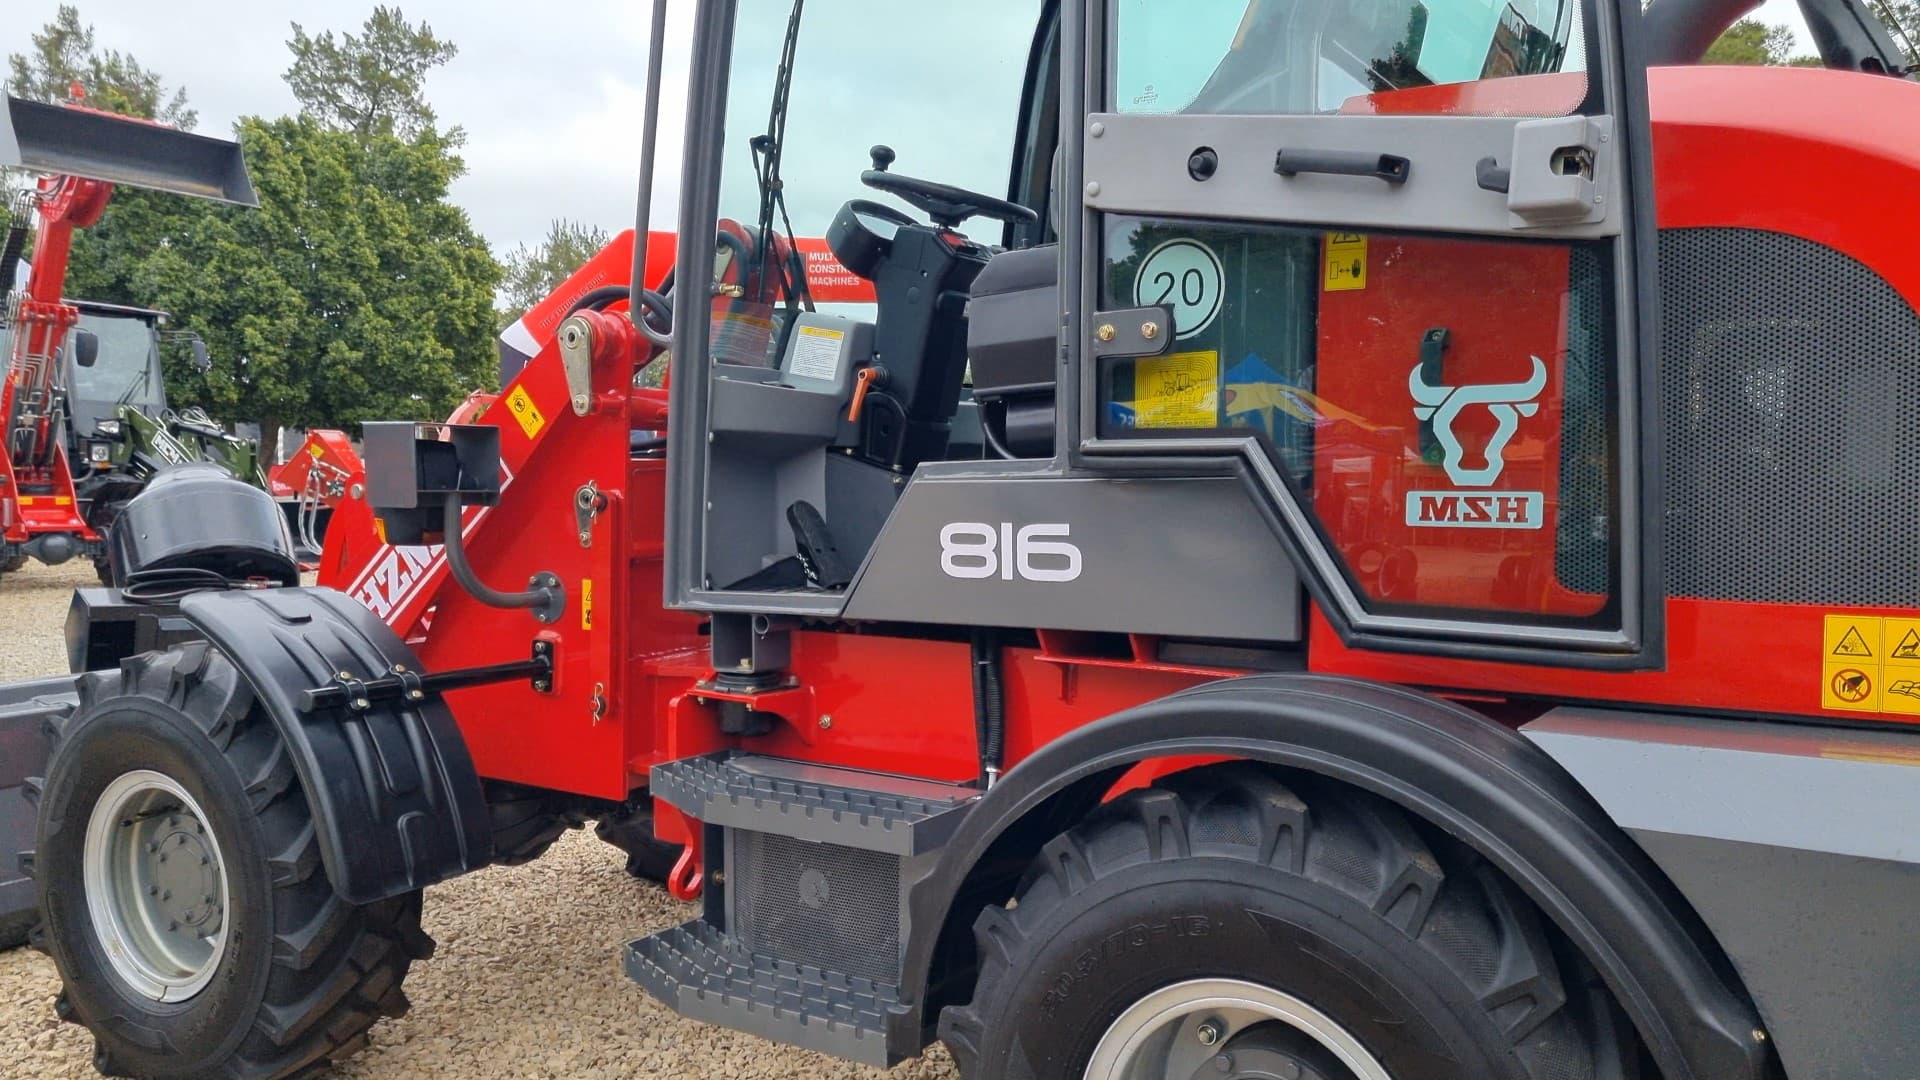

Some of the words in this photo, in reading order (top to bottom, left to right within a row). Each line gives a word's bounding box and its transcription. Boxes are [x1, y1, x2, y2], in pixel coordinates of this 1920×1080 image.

[809, 252, 833, 262] MULT
[809, 276, 860, 287] MACHINES
[1153, 268, 1204, 307] 20
[939, 521, 1083, 583] 816
